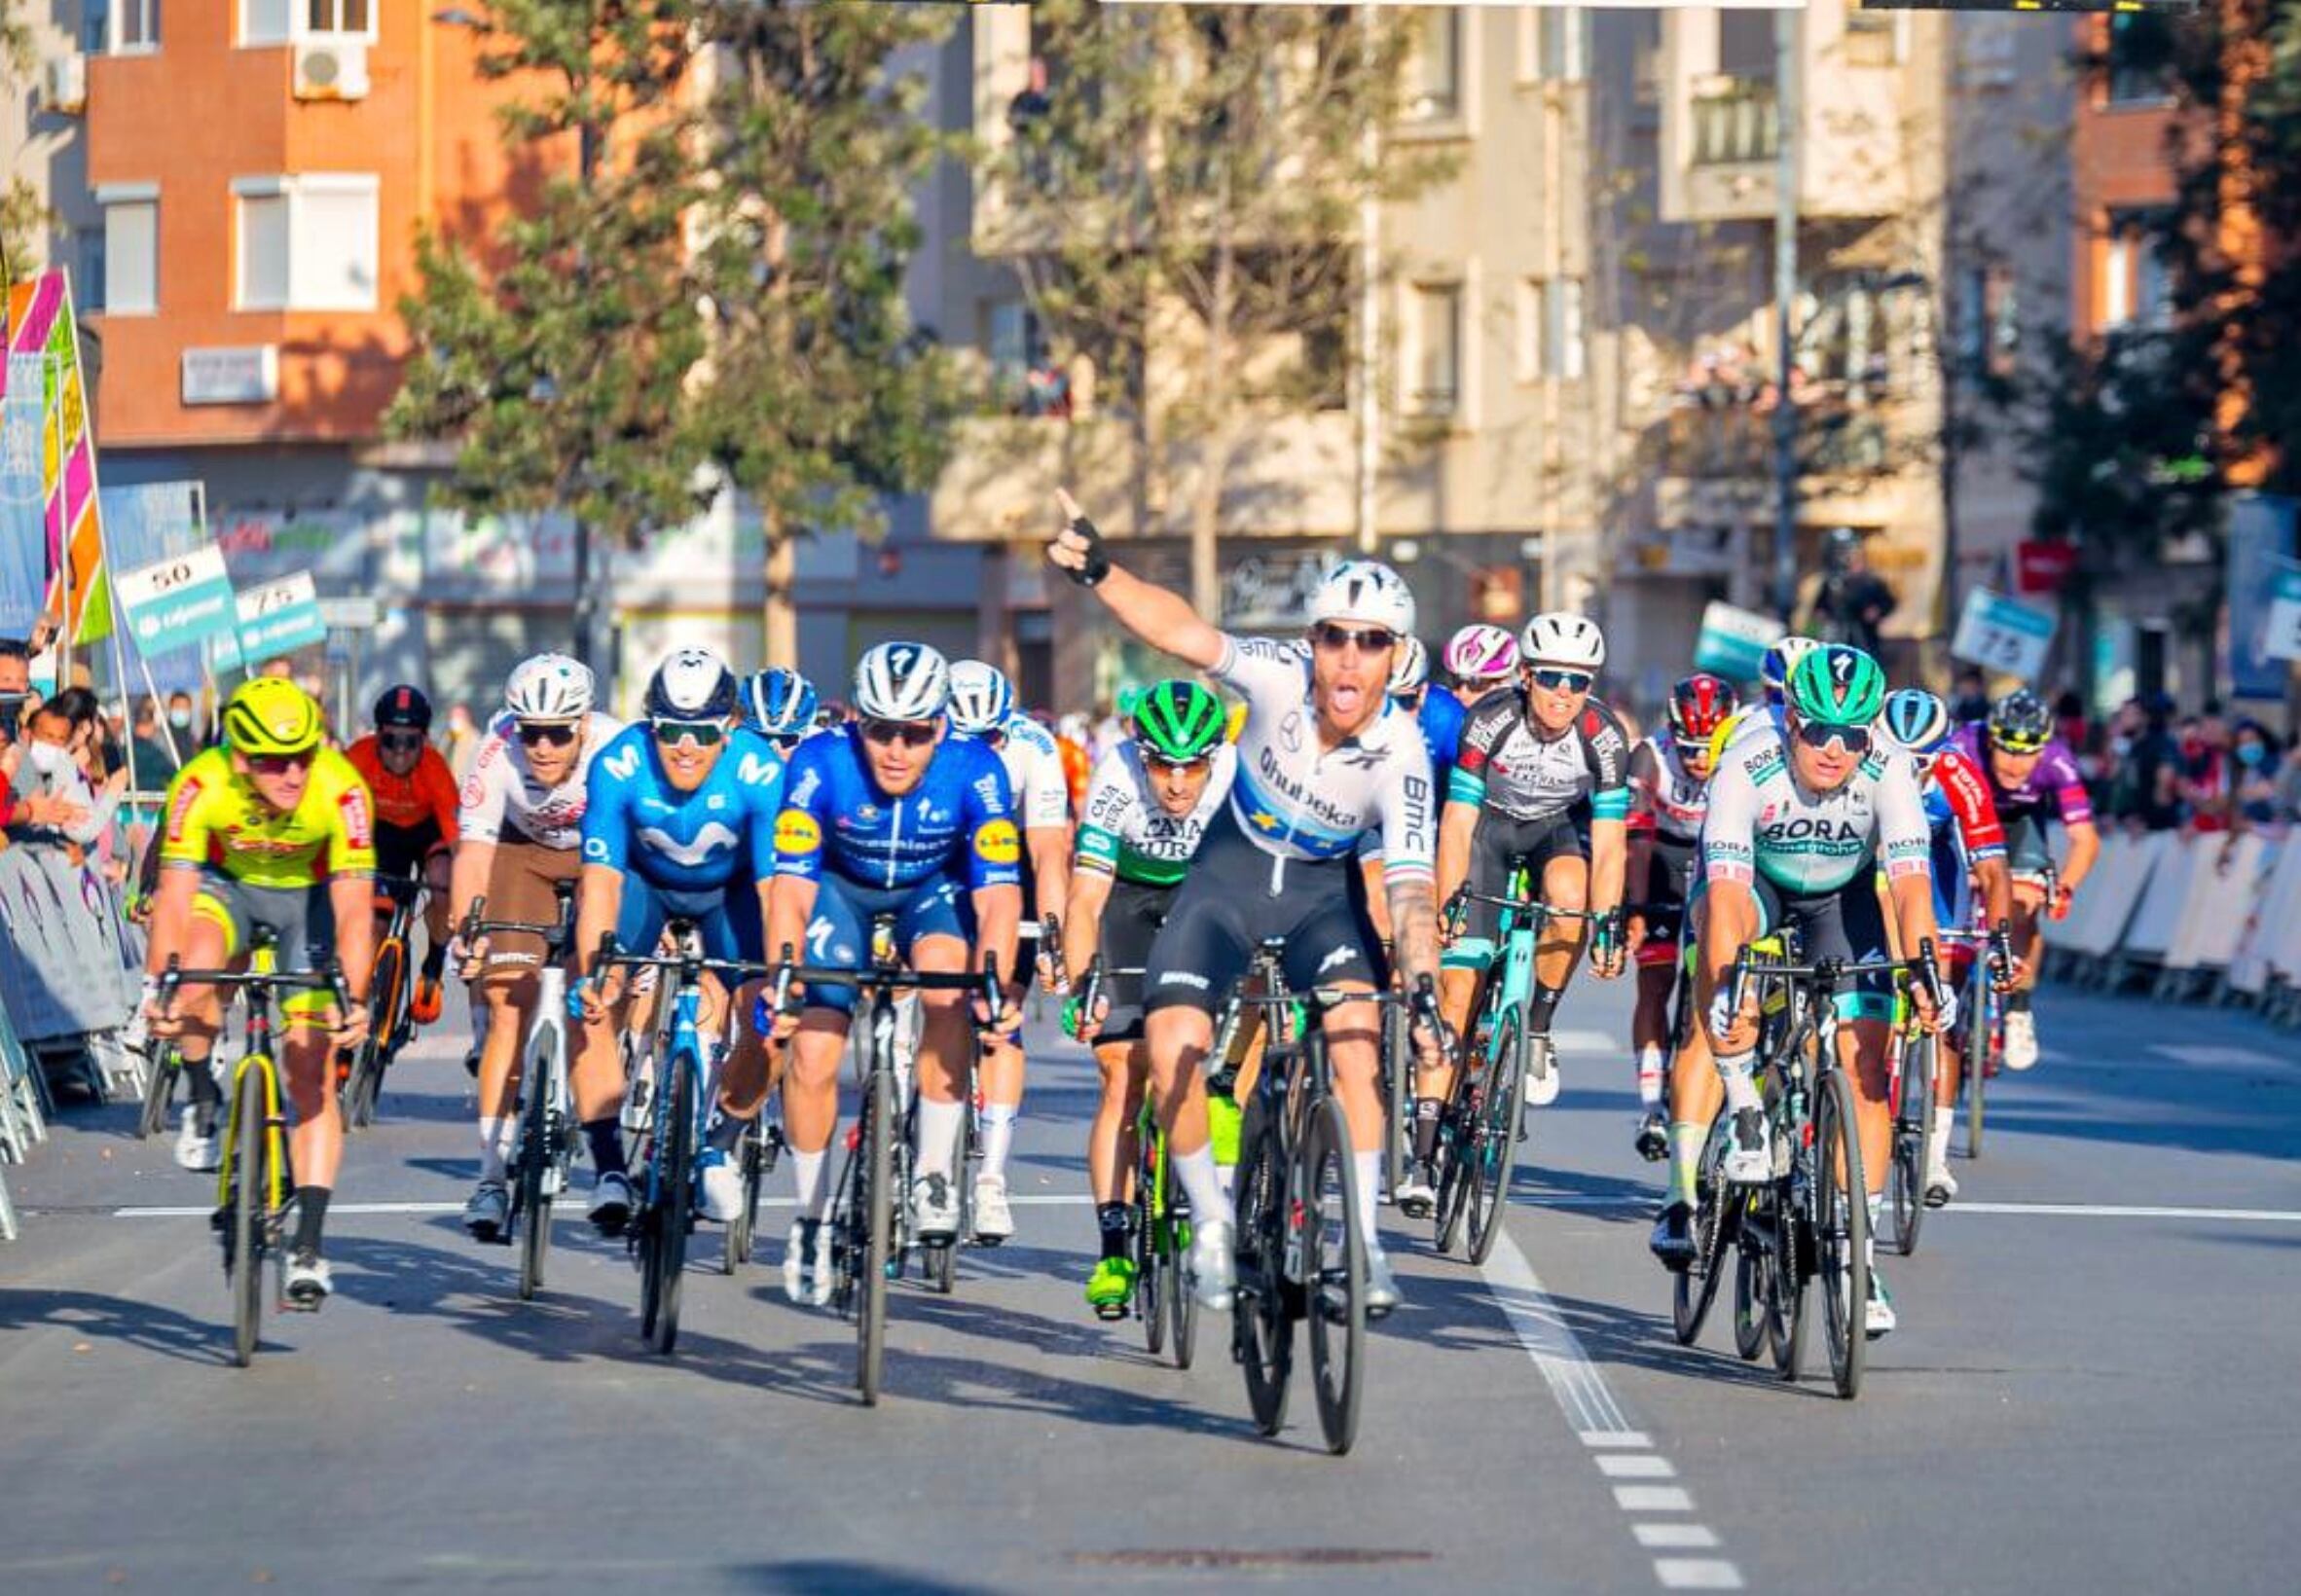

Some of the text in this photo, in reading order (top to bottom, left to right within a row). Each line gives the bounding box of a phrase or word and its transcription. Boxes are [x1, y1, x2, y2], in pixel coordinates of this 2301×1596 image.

[152, 563, 192, 588] 50
[251, 590, 293, 615] 75
[1977, 629, 2024, 664] 75
[1671, 779, 1709, 807] UA
[1404, 774, 1428, 852] BMC
[1761, 817, 1861, 842] BORA
